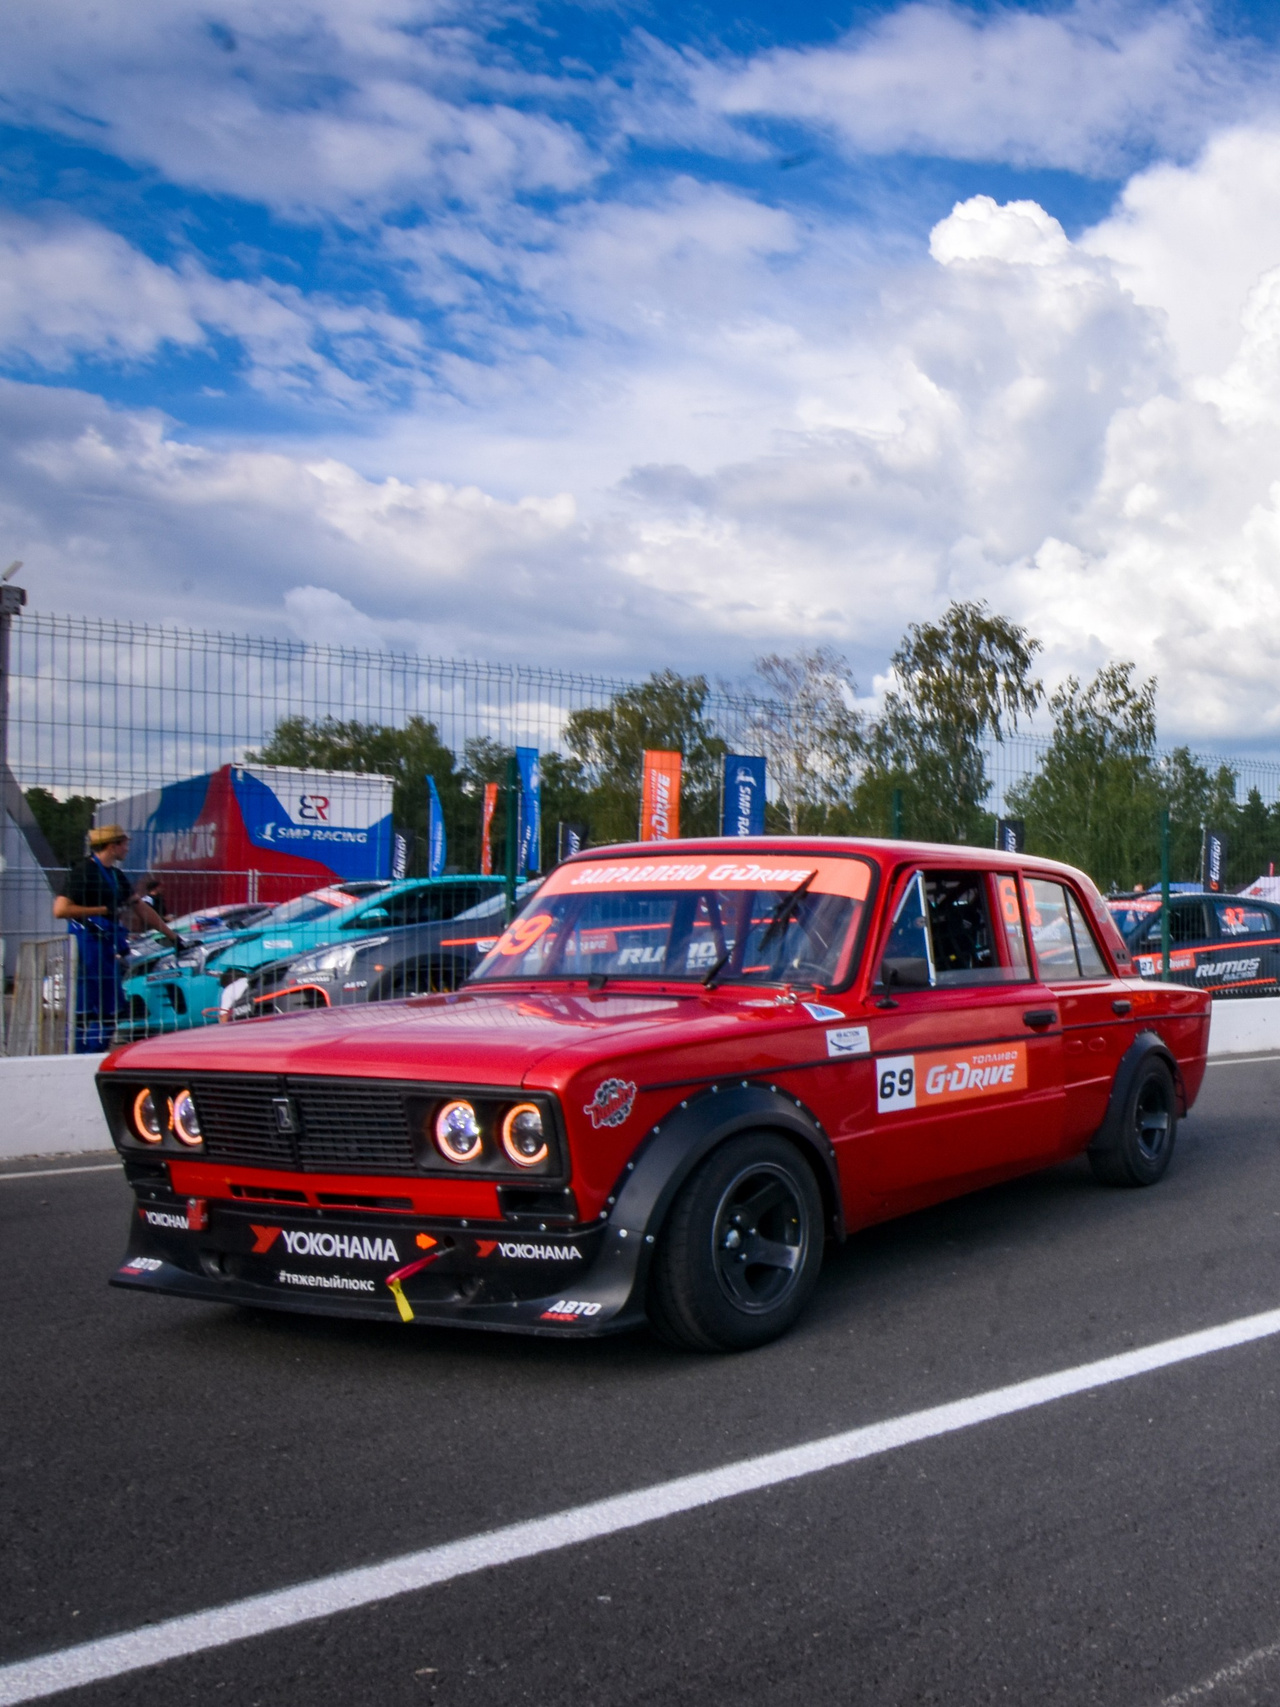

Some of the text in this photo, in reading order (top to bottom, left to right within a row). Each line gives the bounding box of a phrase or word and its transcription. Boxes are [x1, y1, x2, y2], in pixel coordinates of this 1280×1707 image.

[740, 785, 752, 818] SMP
[277, 827, 368, 843] SMP RACING
[571, 864, 707, 885] ЗАПРАВЛЕНО
[1195, 957, 1261, 978] RUMOS
[879, 1068, 914, 1099] 69
[145, 1210, 189, 1230] YOKOHAM
[281, 1230, 400, 1262] YOKOHAMA
[498, 1242, 583, 1260] YOKOHAMA
[278, 1269, 376, 1292] #тяжелыйлюкс
[548, 1299, 602, 1316] АВТО
